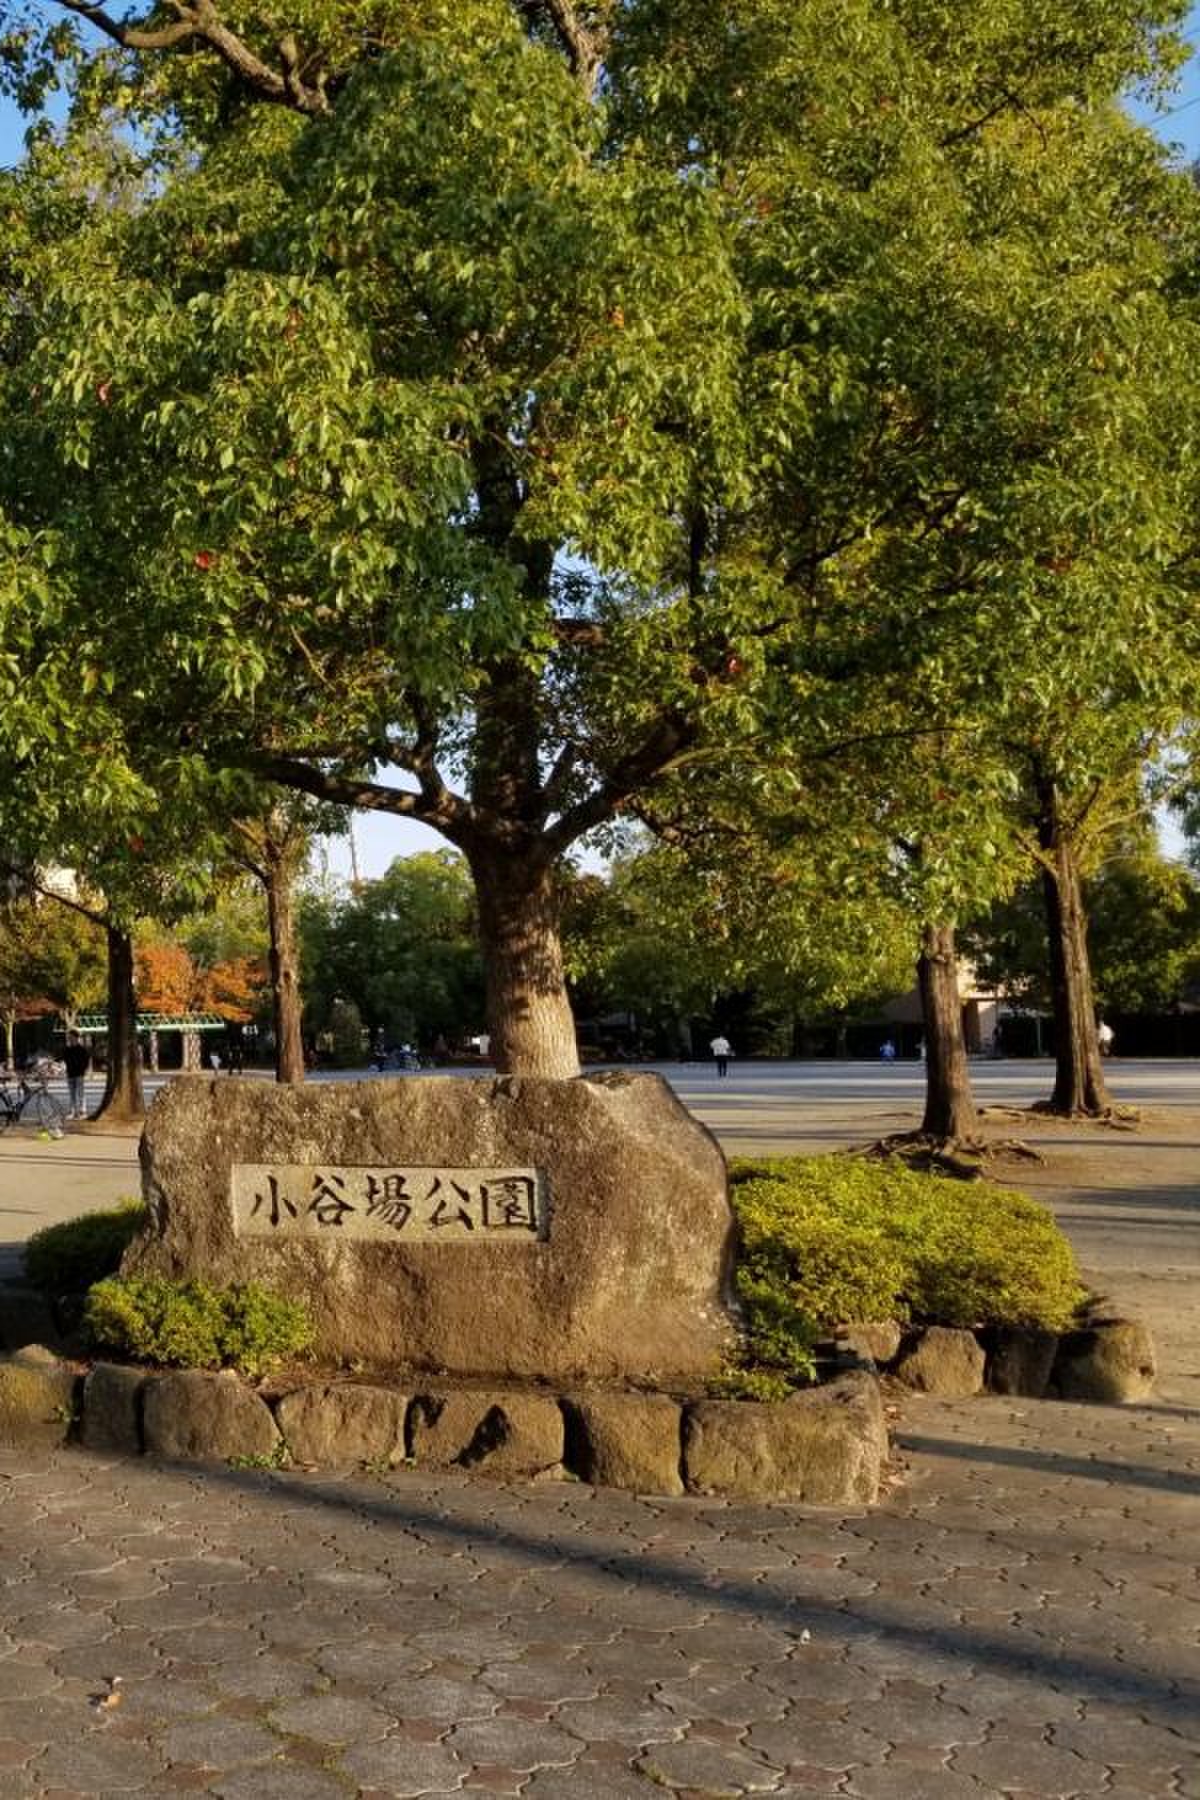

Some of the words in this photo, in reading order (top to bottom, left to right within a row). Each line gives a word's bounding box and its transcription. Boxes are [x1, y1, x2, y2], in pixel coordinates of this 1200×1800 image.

[250, 1174, 538, 1231] 小谷場公園
